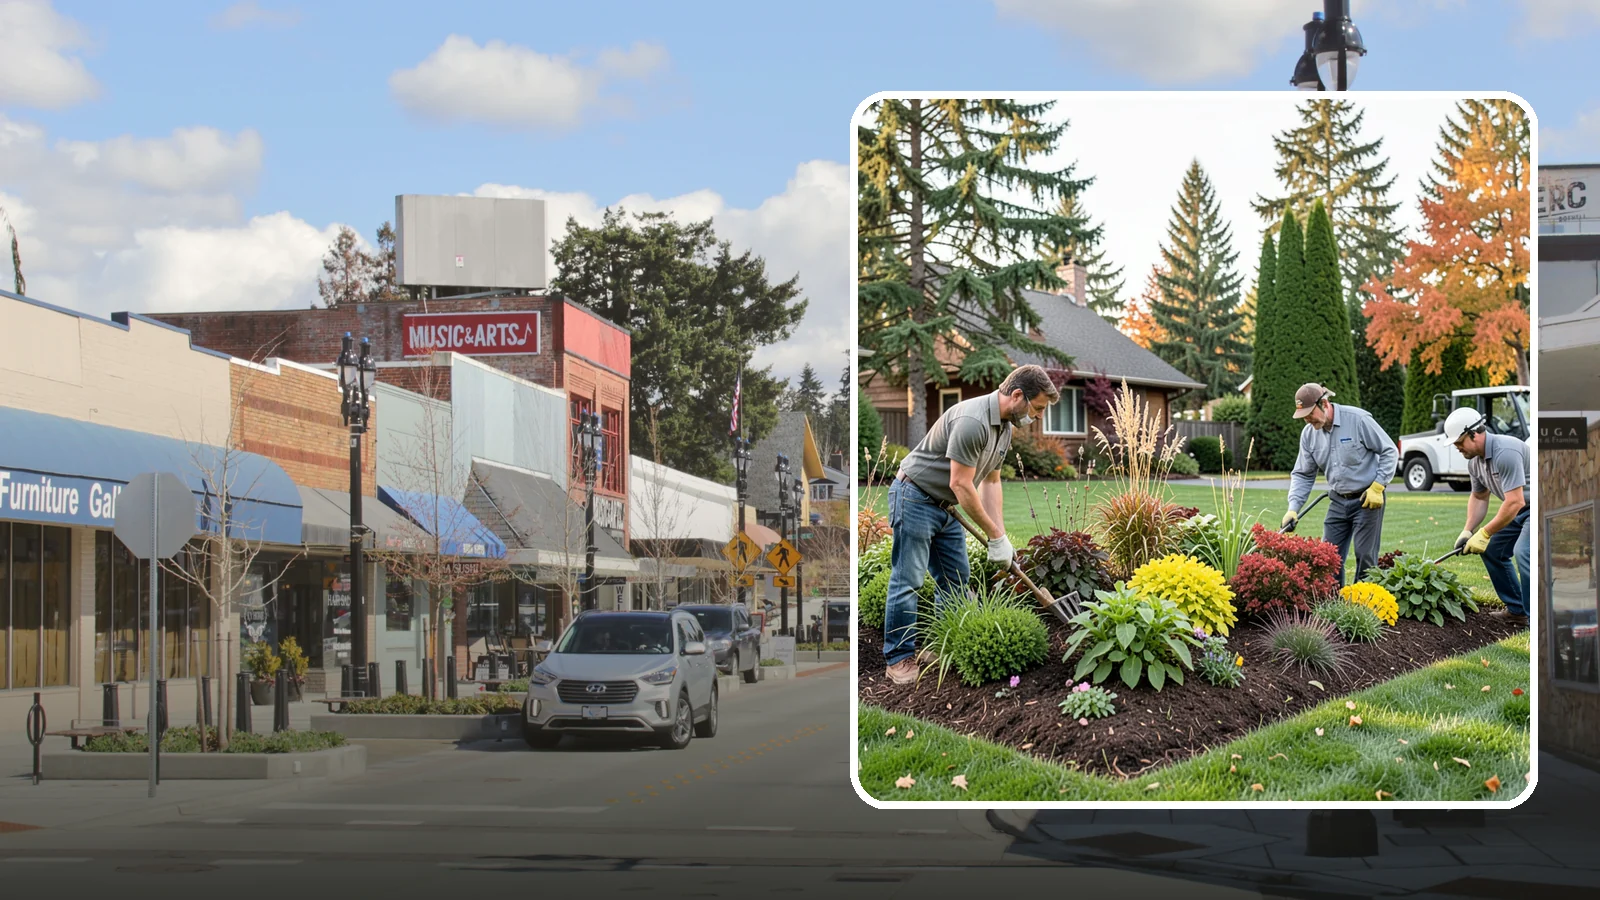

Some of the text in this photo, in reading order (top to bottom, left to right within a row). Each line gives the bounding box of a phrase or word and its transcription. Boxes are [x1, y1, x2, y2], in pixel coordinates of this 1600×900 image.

[1540, 427, 1577, 437] UGA
[0, 471, 121, 519] Furniture Gal
[453, 563, 480, 574] SUSHI
